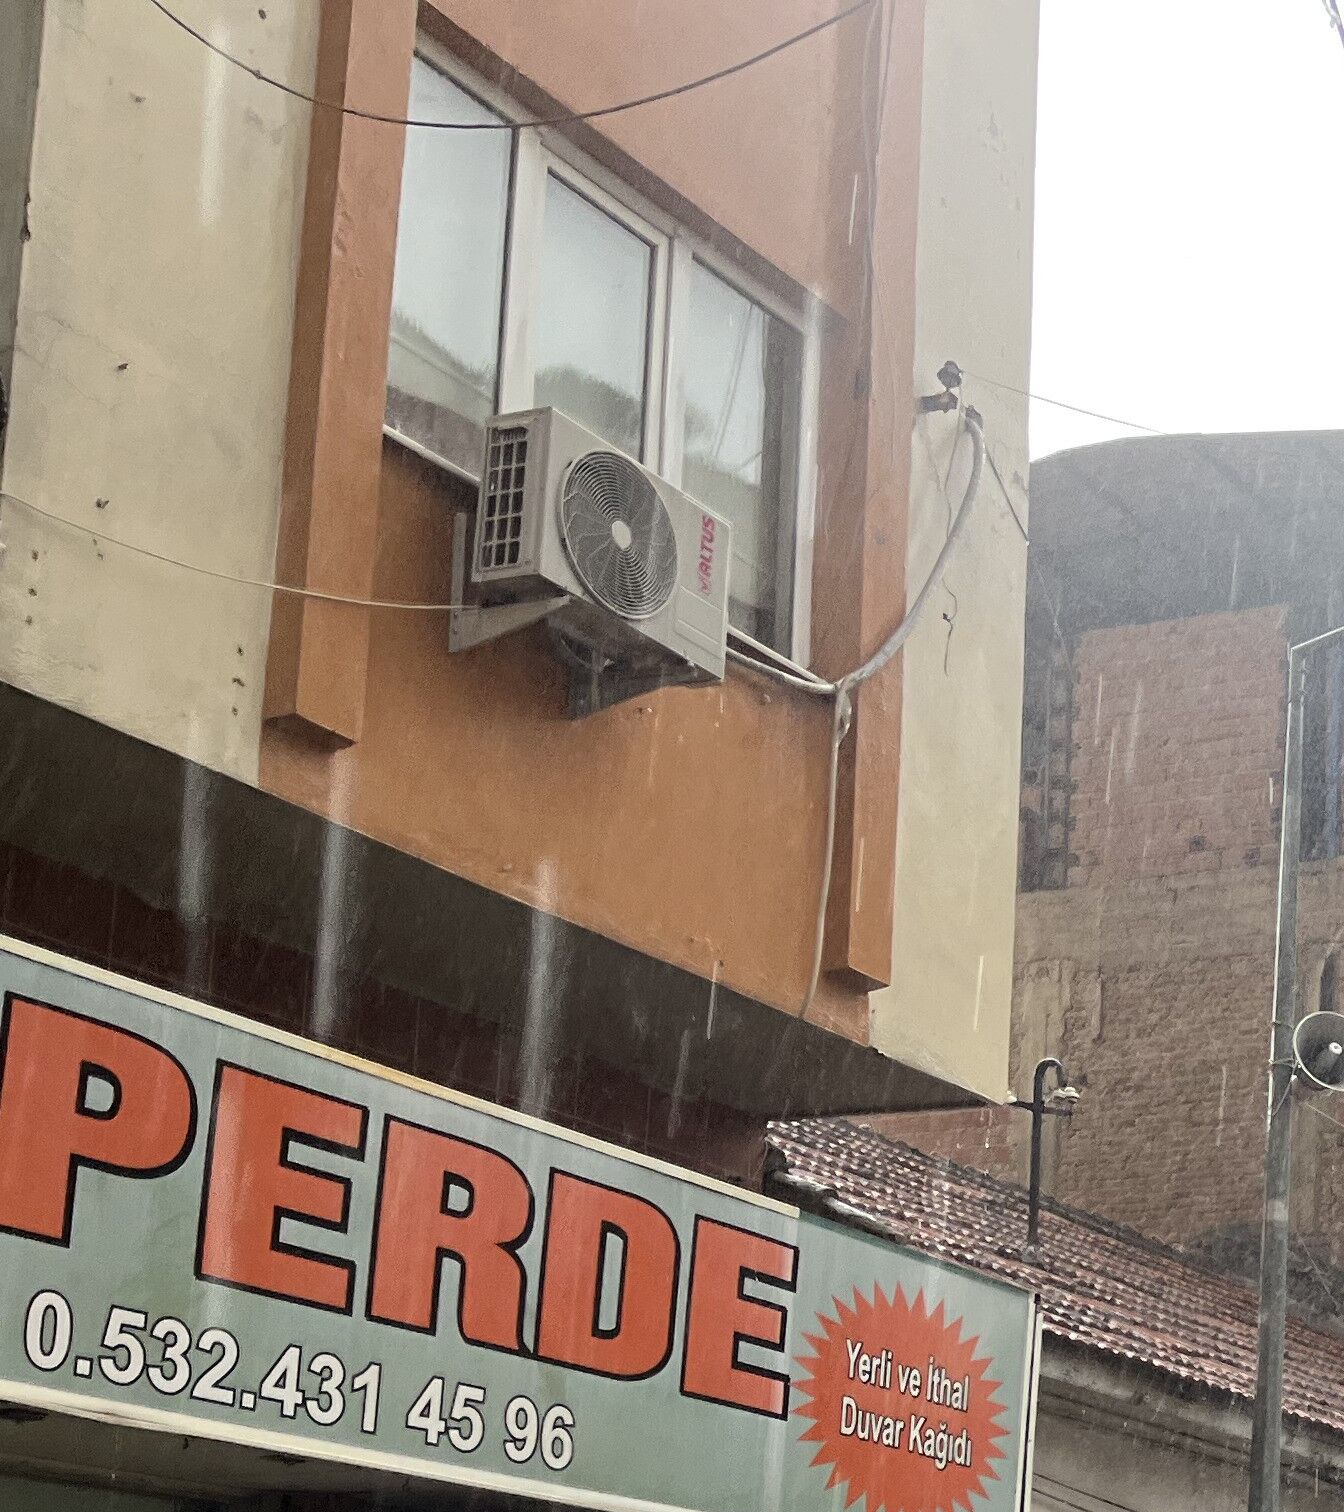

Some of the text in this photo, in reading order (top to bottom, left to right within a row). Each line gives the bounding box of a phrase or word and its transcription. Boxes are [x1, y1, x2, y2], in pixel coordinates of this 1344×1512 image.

[700, 515, 715, 577] ALTUS
[0, 990, 800, 1421] PERDE
[24, 1289, 575, 1470] 0.532.431 45 96
[846, 1339, 969, 1412] Yerli ve İthal
[840, 1396, 972, 1470] Duvar Kağıdı
